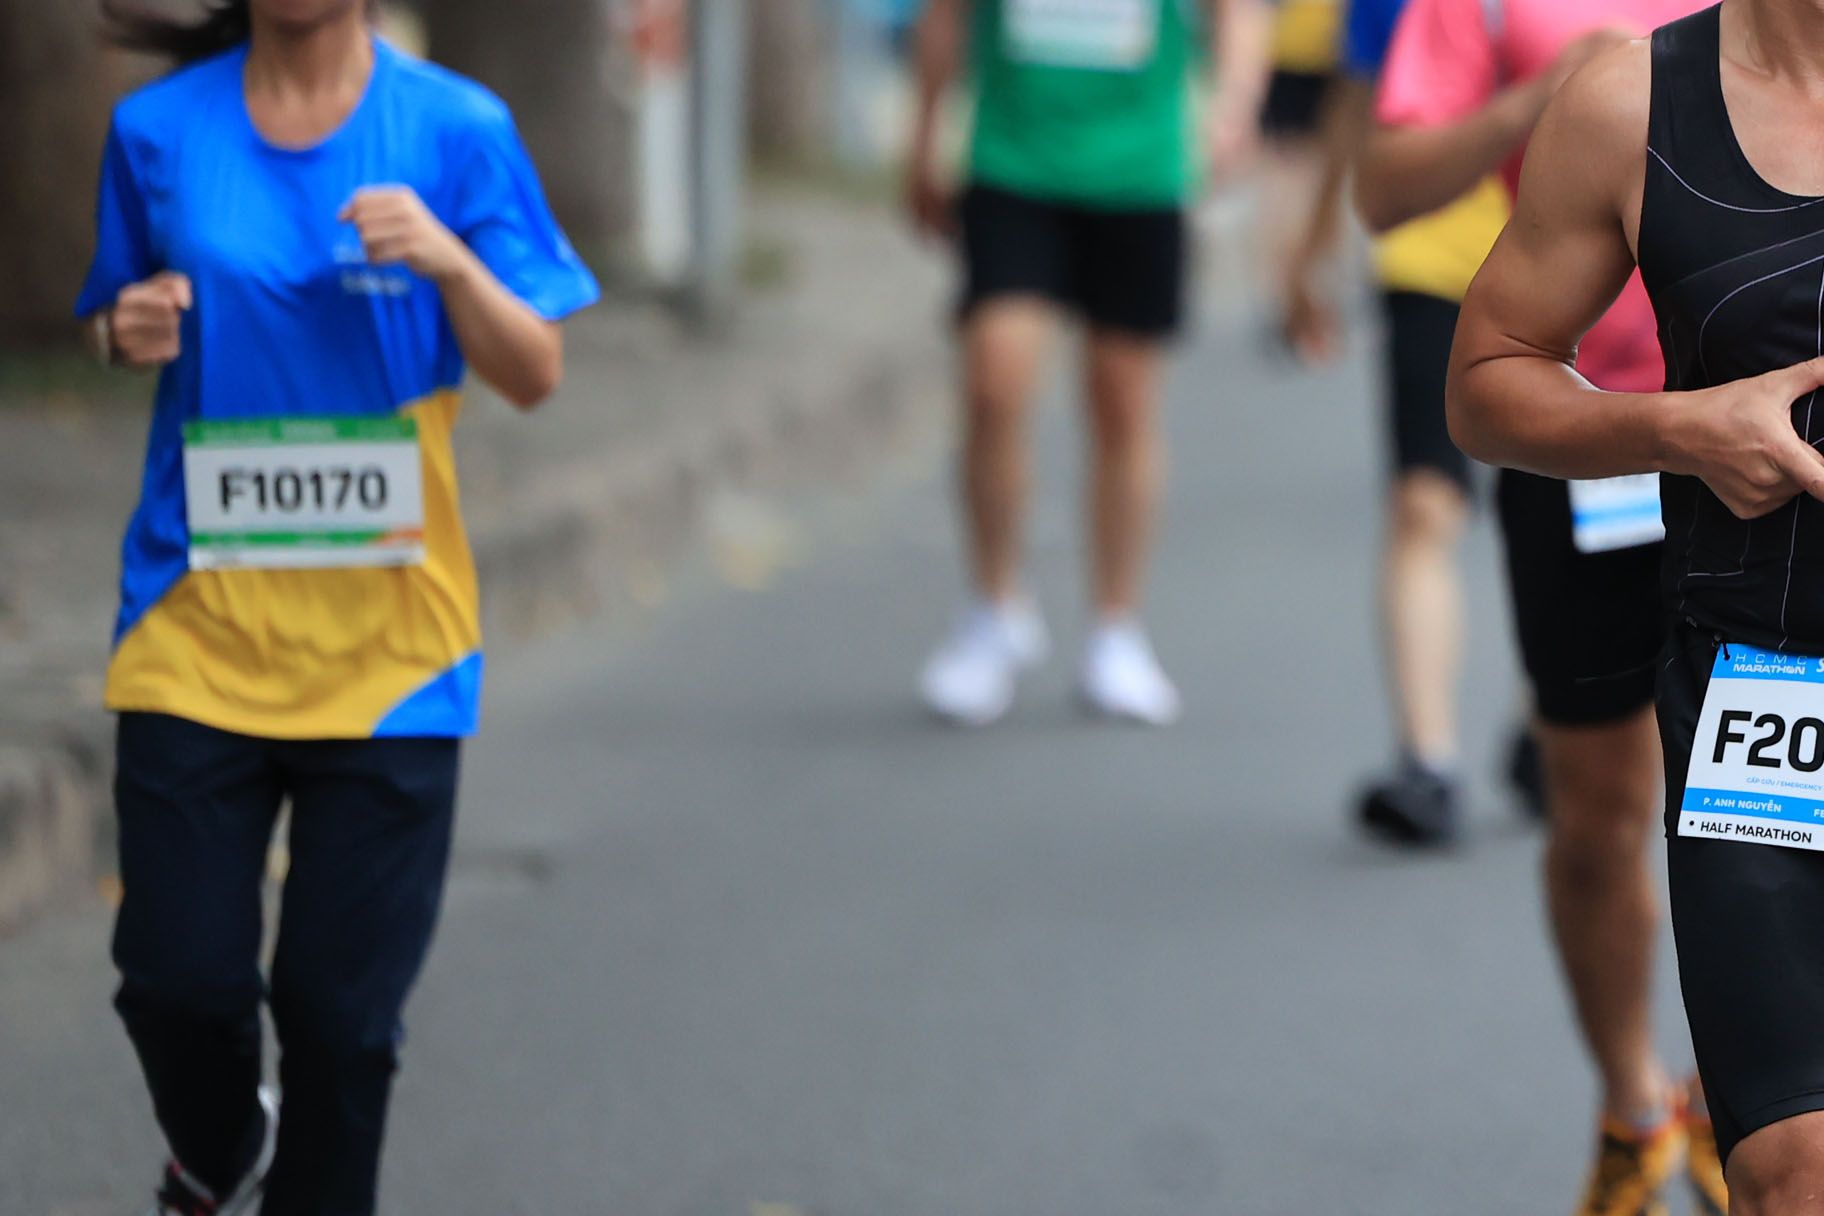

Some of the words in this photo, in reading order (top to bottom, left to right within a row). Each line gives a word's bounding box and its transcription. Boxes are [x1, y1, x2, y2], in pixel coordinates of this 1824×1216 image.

[219, 465, 388, 513] F10170
[1733, 663, 1806, 675] MARATHON
[1714, 797, 1735, 808] ANH
[1700, 821, 1732, 834] HALF
[1735, 824, 1813, 844] MARATHON
